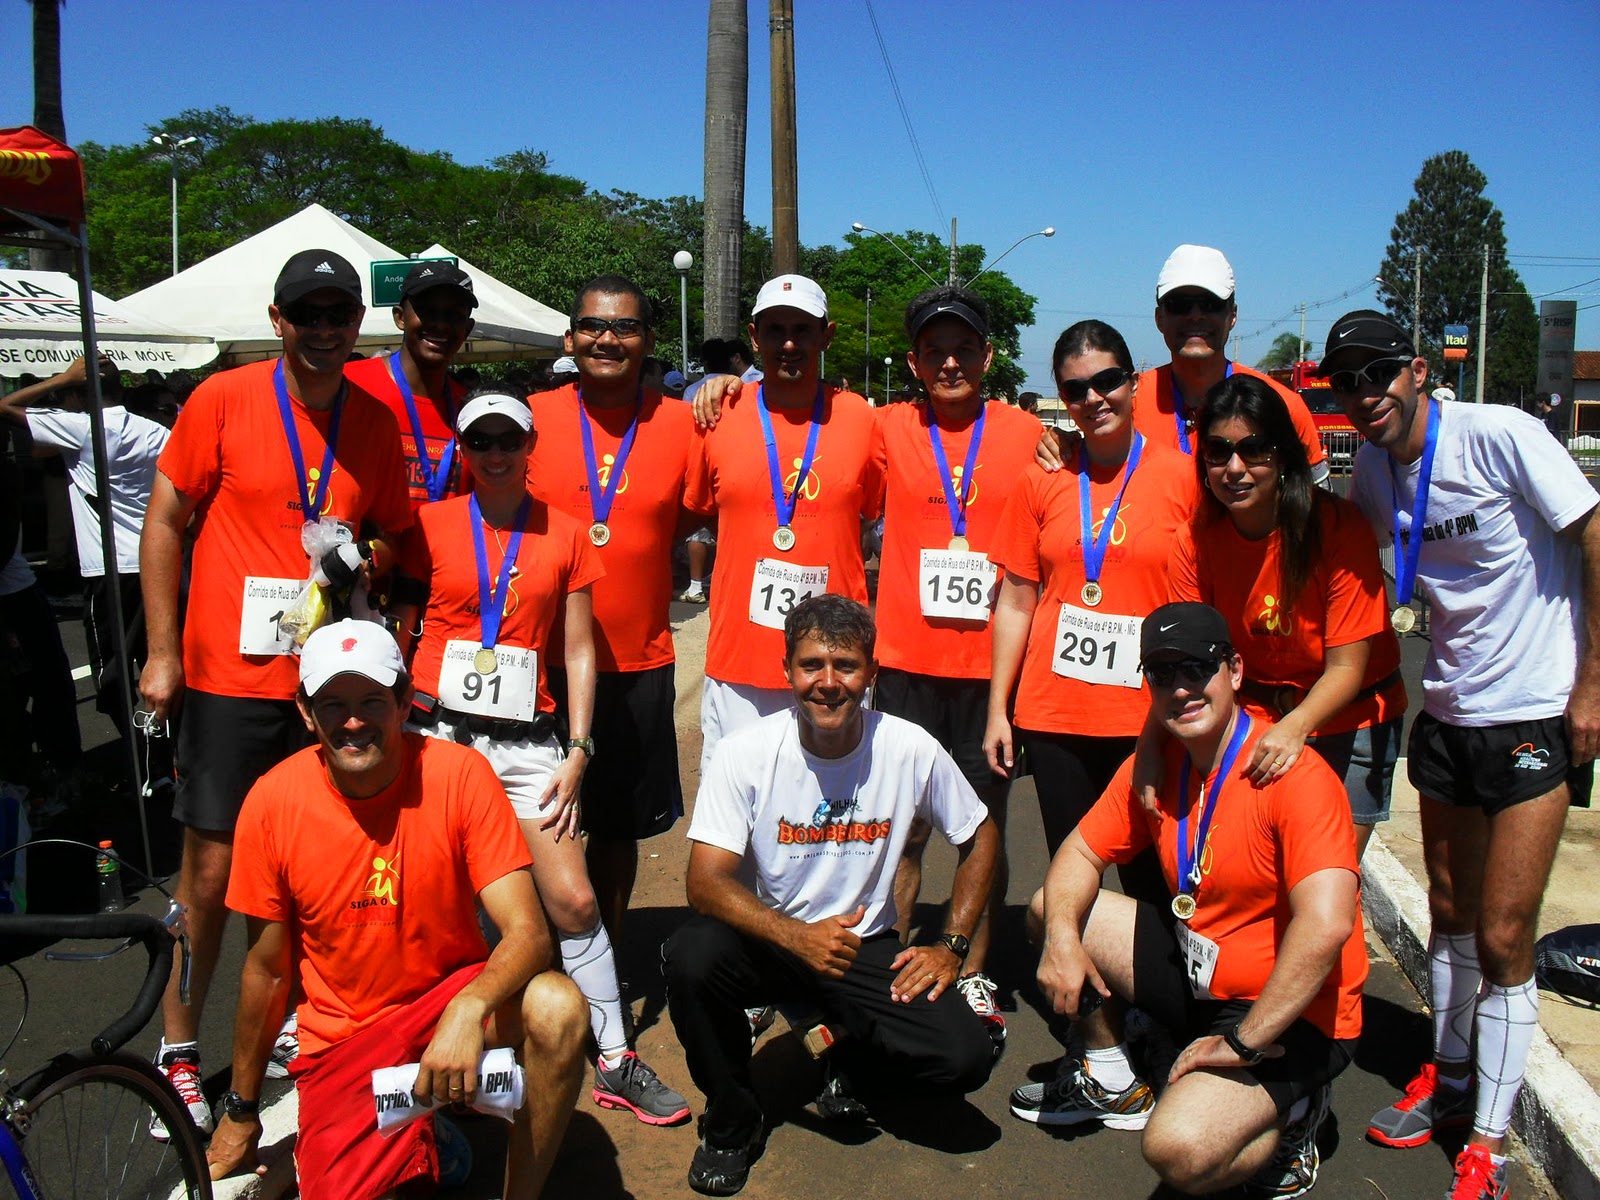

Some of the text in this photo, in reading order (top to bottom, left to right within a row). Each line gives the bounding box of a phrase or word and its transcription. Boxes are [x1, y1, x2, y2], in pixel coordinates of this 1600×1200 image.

[0, 303, 110, 316] TAR
[1446, 334, 1467, 345] Itaú
[0, 349, 21, 363] SE
[1455, 513, 1479, 535] BPM
[758, 562, 775, 577] Corrida
[783, 568, 792, 581] Rua
[924, 556, 940, 568] Corrida
[948, 557, 958, 569] Rua
[248, 584, 269, 598] Corrida
[269, 586, 277, 598] de
[278, 586, 289, 599] Rua
[928, 574, 982, 605] 156
[1062, 611, 1077, 627] Corrida
[1084, 617, 1093, 631] Rua
[447, 647, 467, 661] Corrida
[520, 655, 529, 669] MG
[1060, 631, 1117, 670] 291
[462, 671, 502, 705] 91
[778, 817, 892, 845] BOMBEIROS
[351, 898, 388, 909] SIGA O
[485, 1070, 513, 1093] BPM
